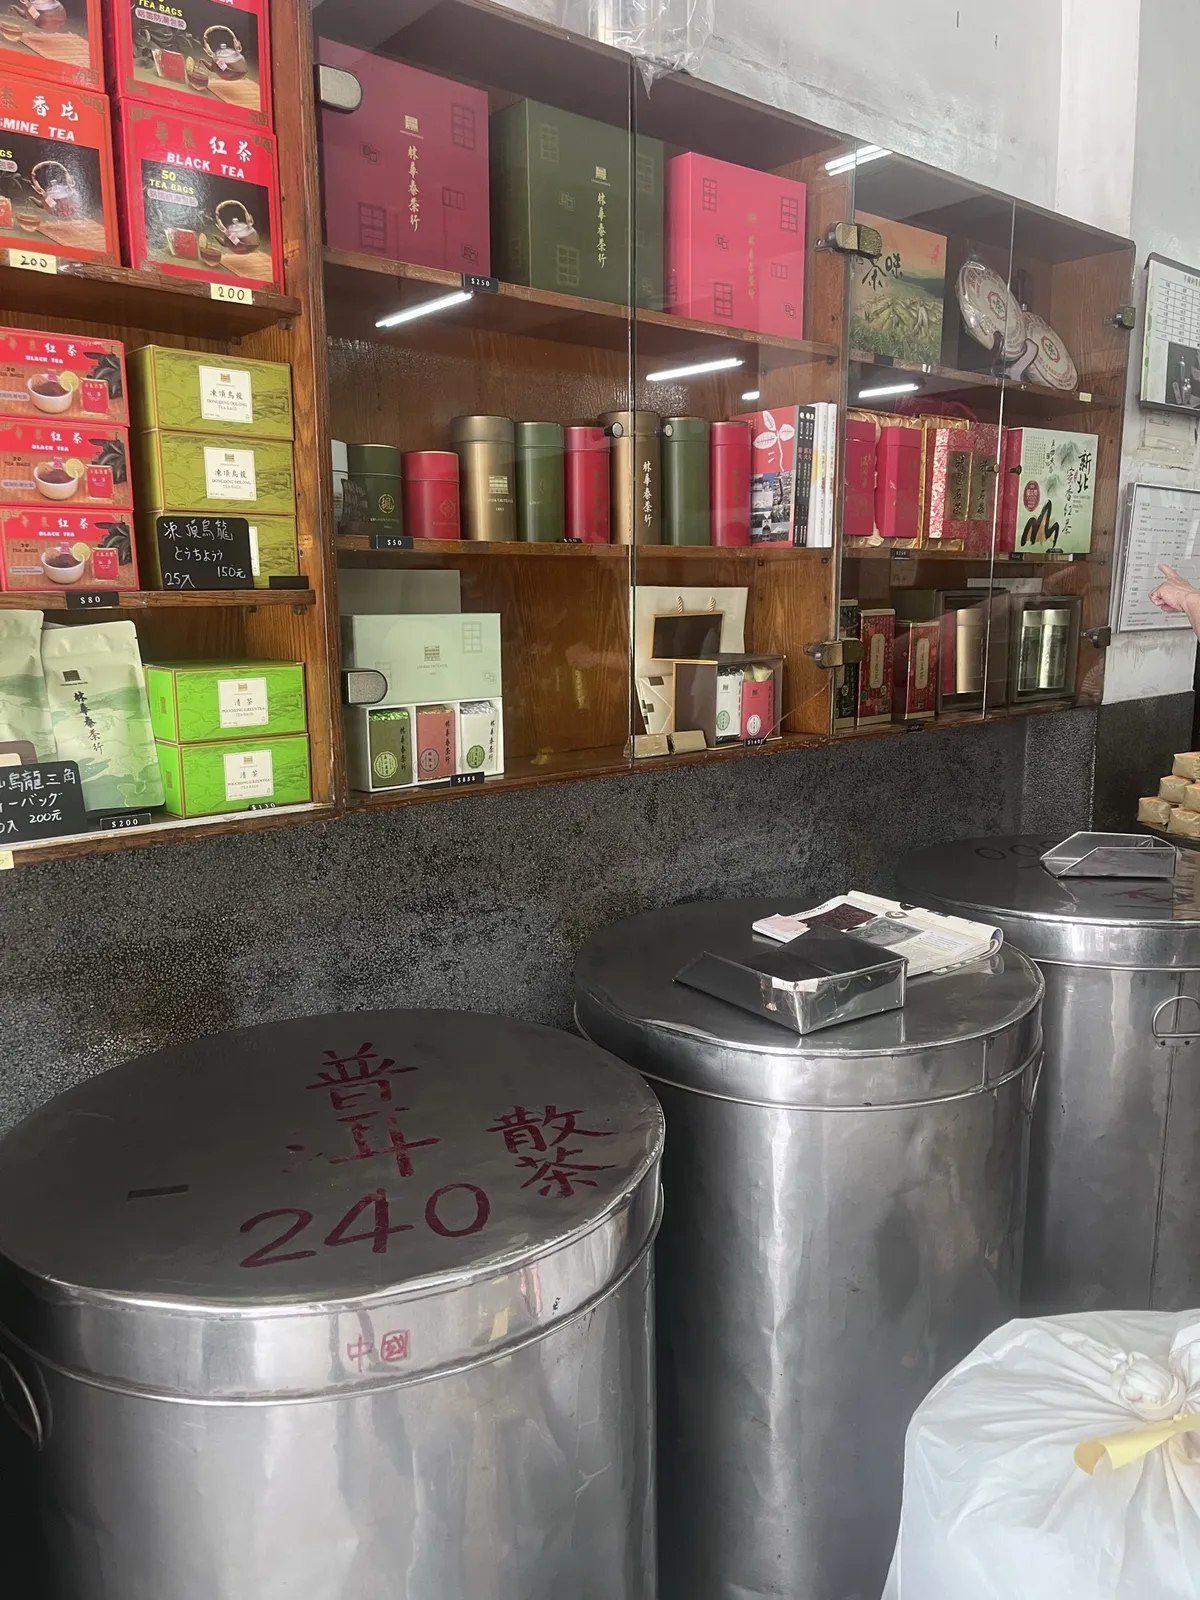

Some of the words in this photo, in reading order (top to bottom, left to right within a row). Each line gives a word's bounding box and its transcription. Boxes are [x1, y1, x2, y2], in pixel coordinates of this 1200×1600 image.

[159, 5, 183, 17] BAGS
[48, 126, 75, 141] TEA
[209, 136, 252, 162] 紅茶
[166, 152, 211, 171] BLACK
[221, 164, 245, 179] TEA
[161, 169, 177, 181] 50
[149, 179, 168, 190] TEA
[170, 183, 195, 195] BAGS
[20, 255, 48, 269] 200
[470, 277, 490, 287] $250
[217, 286, 245, 301] 200
[1076, 450, 1092, 494] 新北
[217, 565, 247, 579] 150元
[164, 572, 196, 589] 25入
[80, 595, 101, 605] $80
[29, 809, 62, 824] 200元
[111, 818, 139, 828] $200
[485, 1105, 617, 1198] 散茶
[239, 1182, 491, 1269] 240
[346, 1329, 410, 1373] 中國
